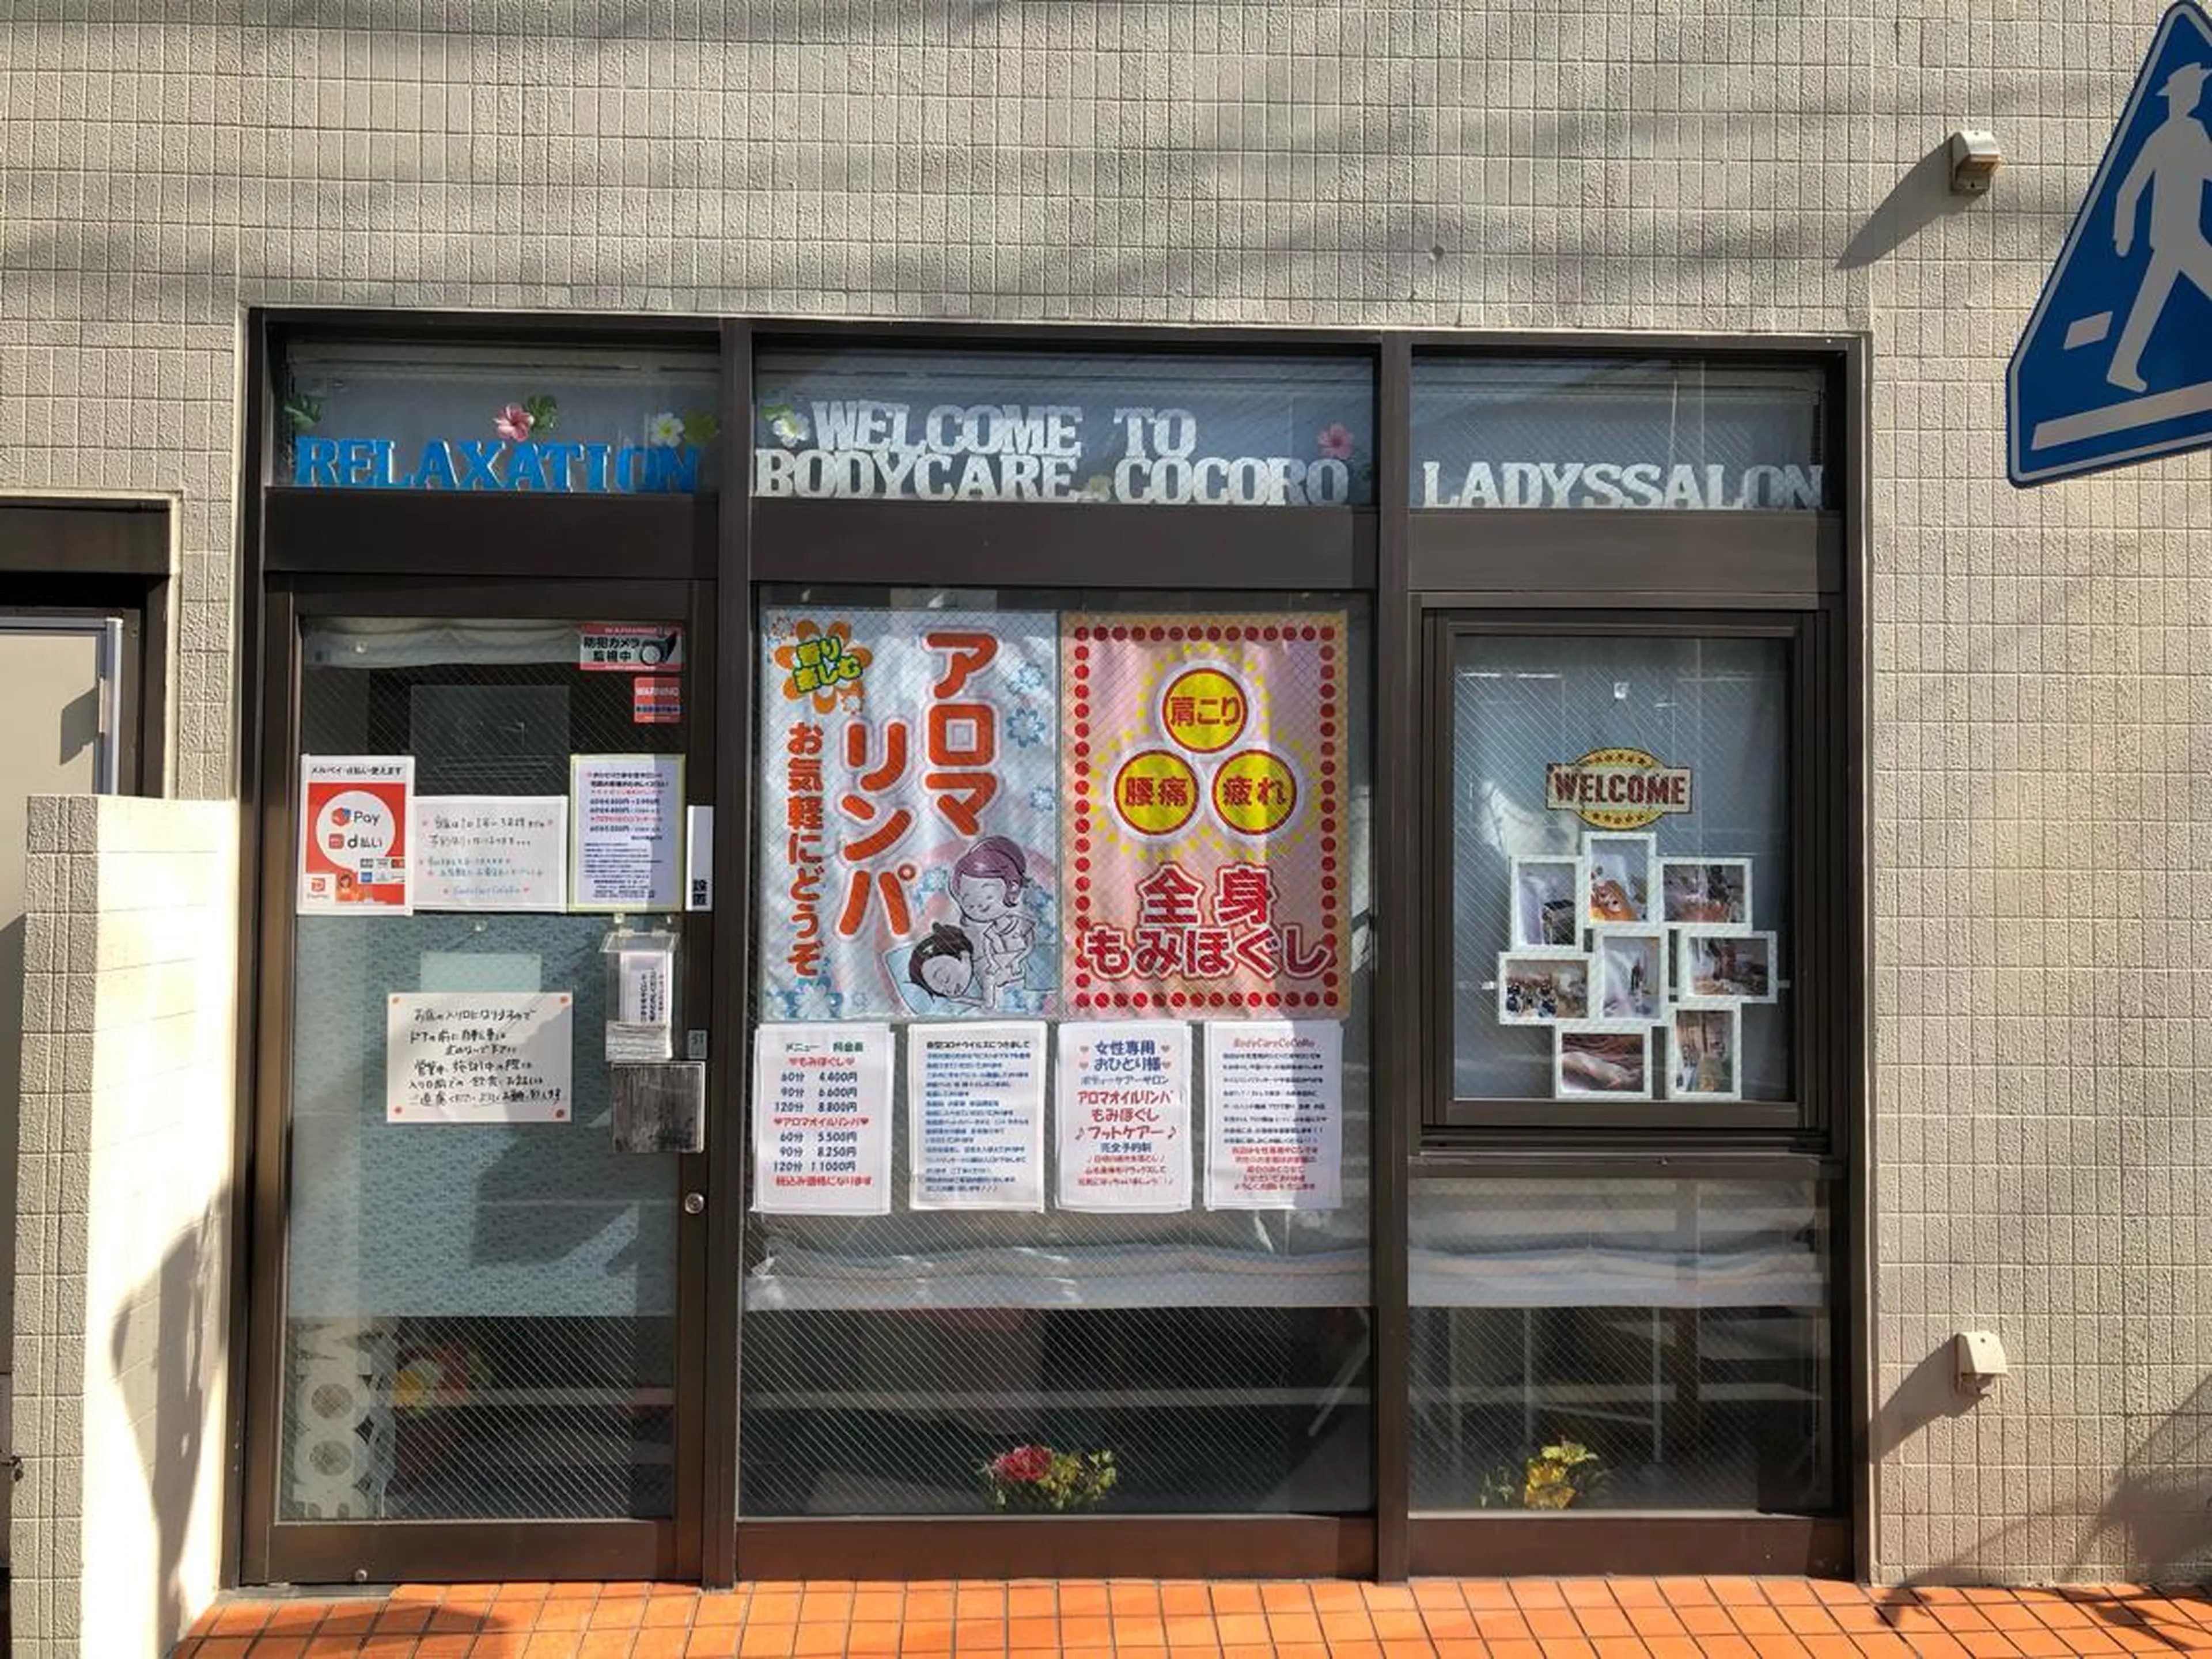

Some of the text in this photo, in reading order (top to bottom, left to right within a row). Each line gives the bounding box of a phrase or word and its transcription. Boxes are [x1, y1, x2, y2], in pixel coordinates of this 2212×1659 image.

[812, 400, 1195, 460] WELCOME TO
[294, 436, 700, 493] RELAXATION
[753, 449, 1350, 505] BODYCARE COCORO
[1422, 462, 1824, 510] LADYSSALON
[584, 637, 639, 649] 防犯カメラ
[1171, 696, 1241, 727] 肩こり
[924, 632, 998, 836] アロマ
[1124, 777, 1189, 806] 腰痛
[1222, 777, 1286, 806] 疲れ
[1554, 772, 1685, 804] WELCOME
[354, 810, 380, 826] Pay
[839, 721, 916, 936] リンパ
[787, 722, 824, 976] お気軽にどうぞ
[1138, 866, 1275, 926] 全身
[1085, 927, 1331, 978] もみほぐし
[786, 1043, 821, 1052] メニュー
[1095, 1040, 1156, 1055] 女性専用
[1094, 1057, 1161, 1071] おひとり様
[1078, 1090, 1174, 1105] アロマオイルリンパ
[1092, 1107, 1160, 1122] もみほぐし
[1087, 1124, 1165, 1139] フットケアー
